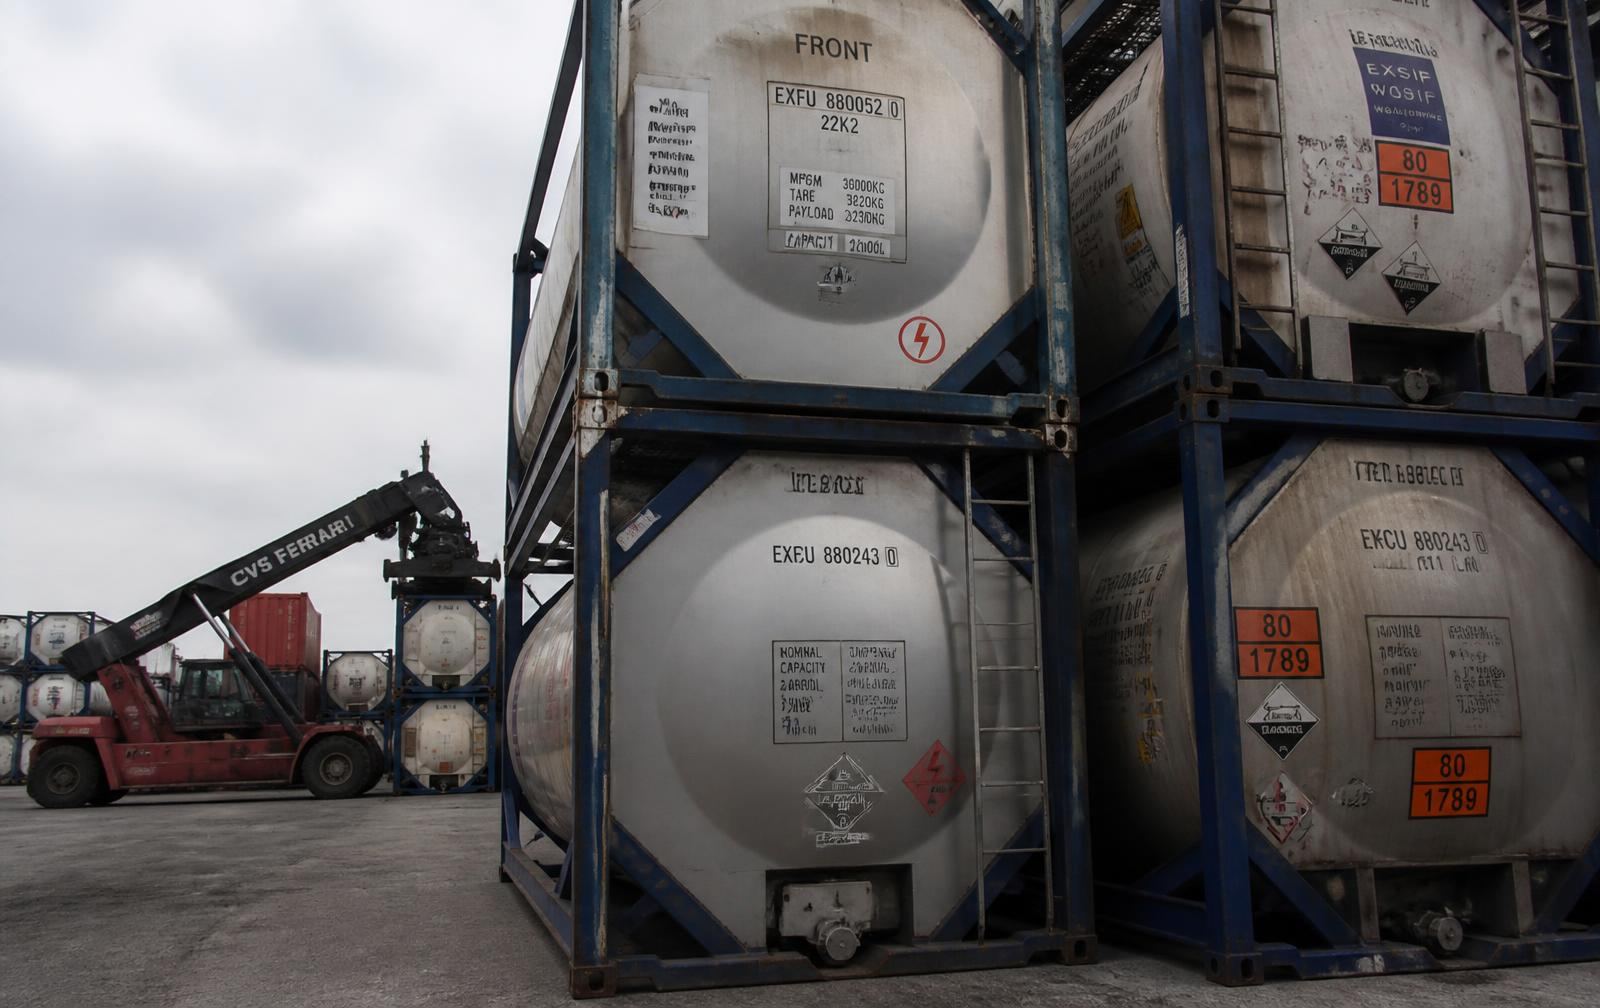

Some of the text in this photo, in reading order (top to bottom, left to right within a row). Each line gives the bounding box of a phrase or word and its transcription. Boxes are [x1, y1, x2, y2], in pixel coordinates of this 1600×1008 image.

[795, 33, 872, 62] FRONT
[1366, 63, 1431, 82] EXSIF
[775, 86, 816, 107] EXFU
[826, 92, 883, 116] 880052
[821, 114, 859, 134] 22K2
[1403, 149, 1427, 172] 80
[789, 188, 815, 203] TARE
[1392, 178, 1441, 205] 1789
[788, 204, 834, 221] PAYLOAD
[230, 514, 355, 586] CVS FERRARI
[1413, 530, 1471, 552] 880243
[823, 546, 880, 565] 880243
[1263, 613, 1291, 638] 80
[780, 661, 826, 674] CAPACITY
[1250, 647, 1309, 673] 1789
[1440, 753, 1466, 778] 80
[1424, 787, 1477, 812] 1789
